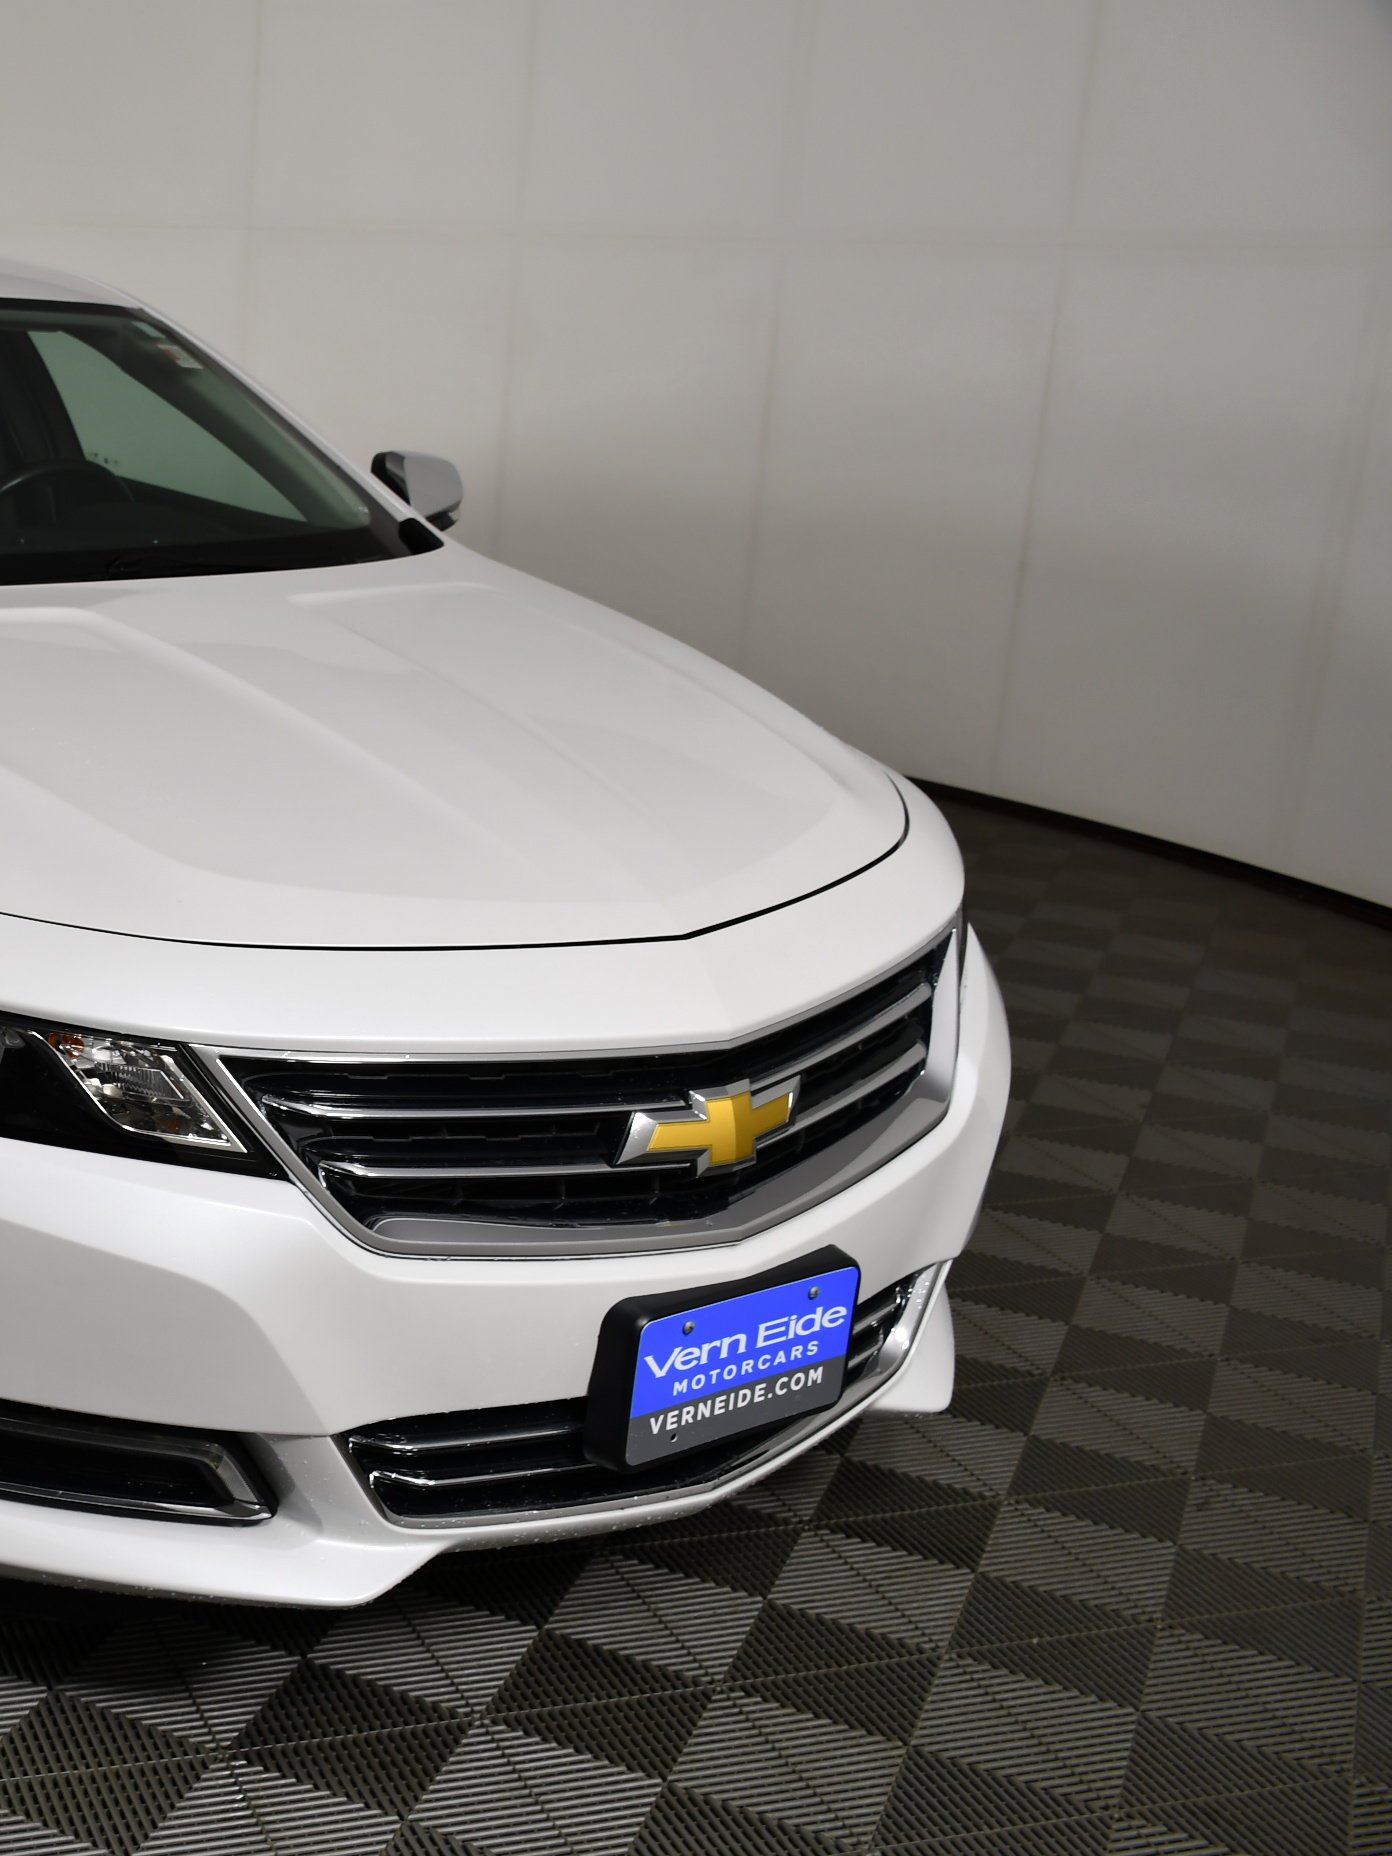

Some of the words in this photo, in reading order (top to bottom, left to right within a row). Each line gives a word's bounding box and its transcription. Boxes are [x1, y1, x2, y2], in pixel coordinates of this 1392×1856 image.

[644, 1333, 748, 1379] Vern
[755, 1306, 847, 1348] Eide
[672, 1341, 819, 1396] MOTORCARS
[649, 1366, 824, 1435] VERNEIDE.COM
